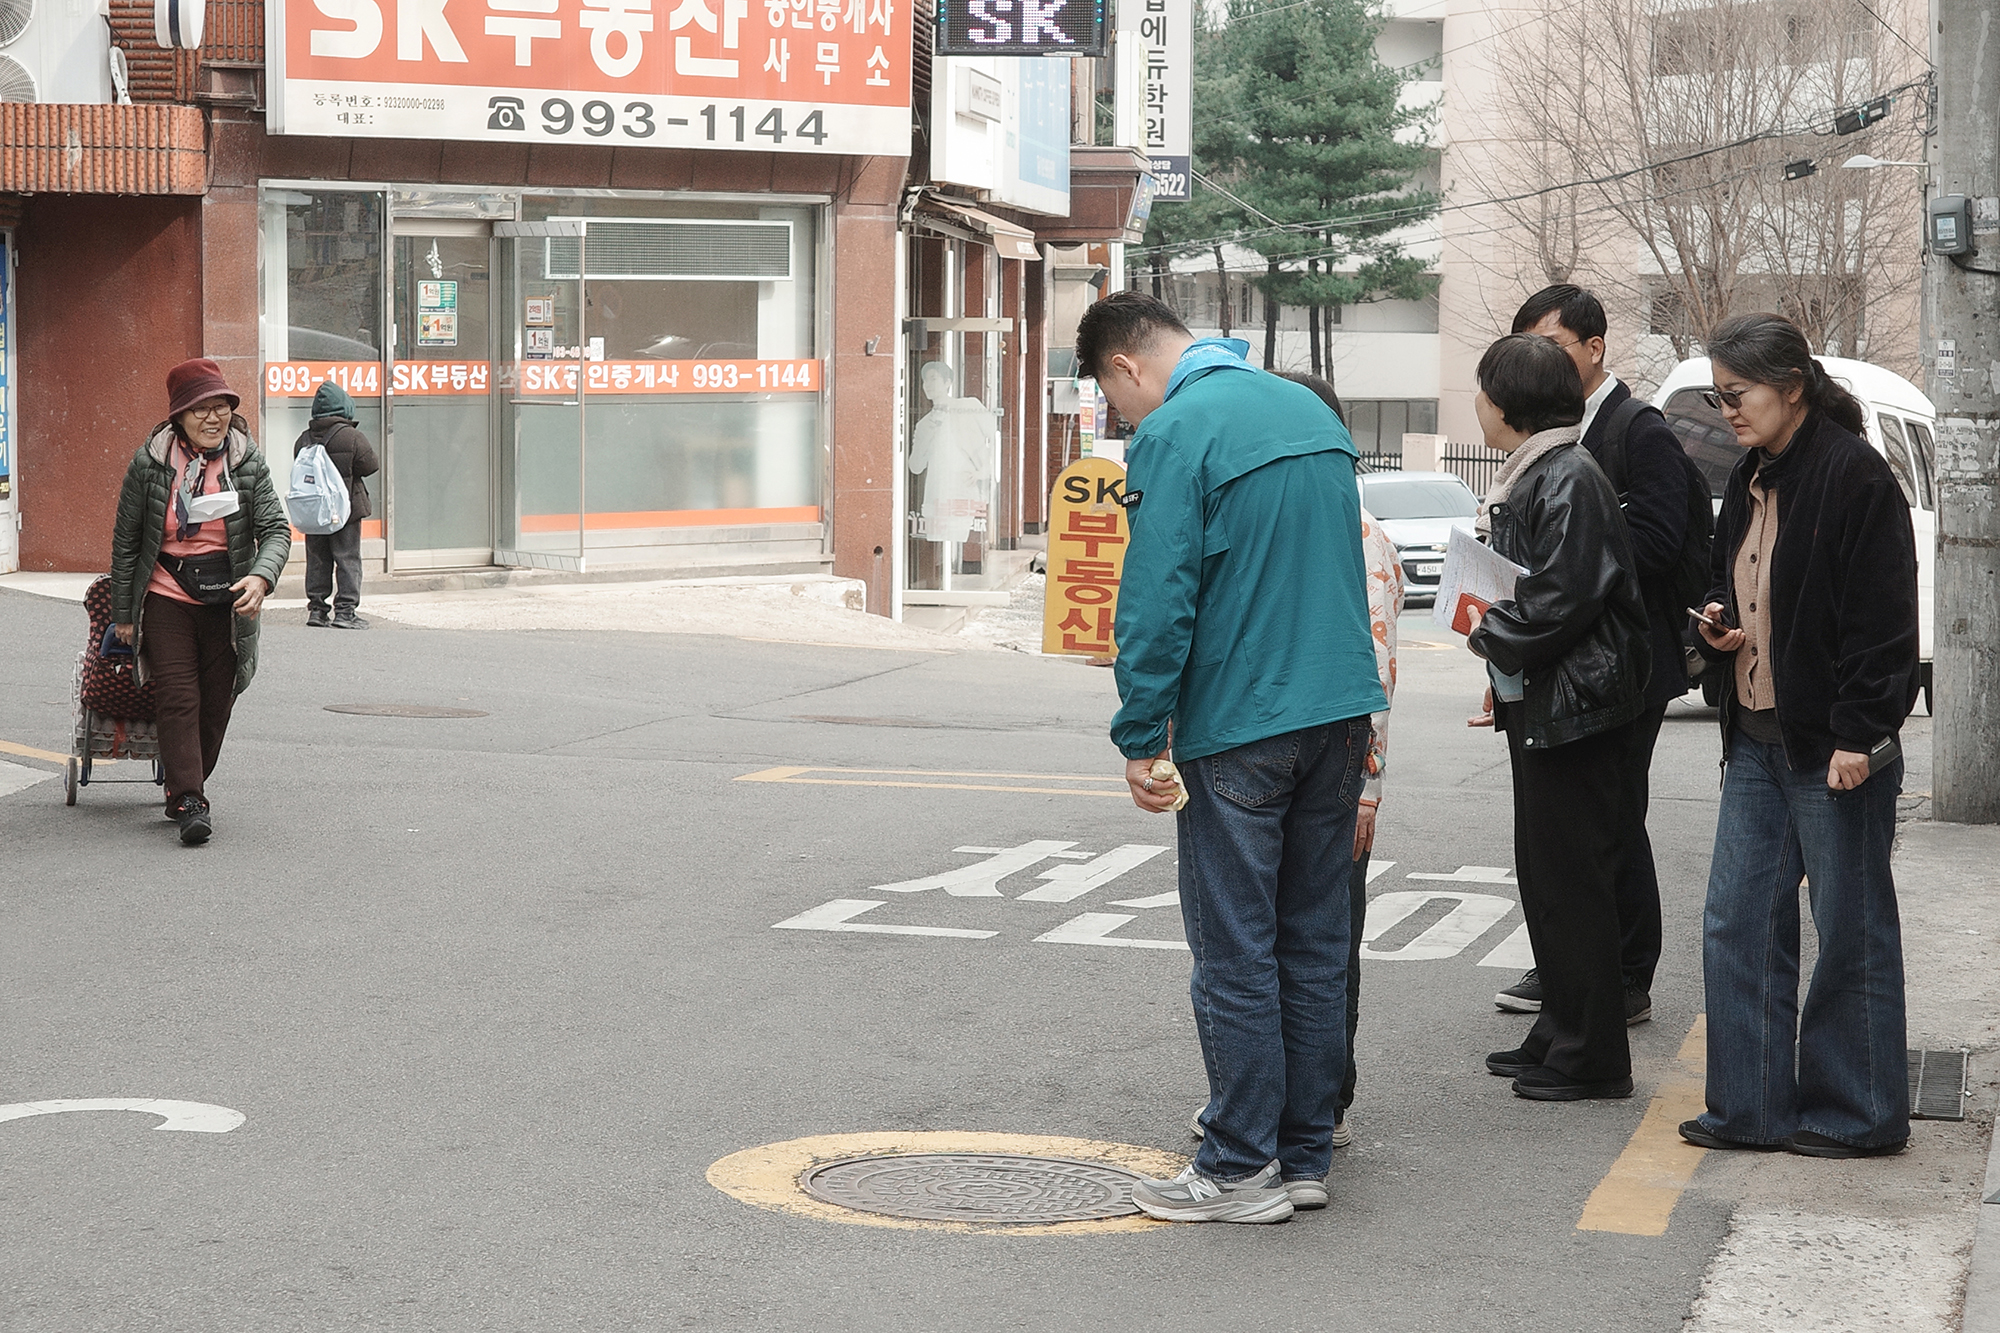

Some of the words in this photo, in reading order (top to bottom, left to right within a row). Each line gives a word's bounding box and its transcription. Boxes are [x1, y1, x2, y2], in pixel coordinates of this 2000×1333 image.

[968, 0, 1075, 44] SK
[541, 97, 828, 146] 993-1144
[1149, 160, 1171, 170] 상담
[267, 366, 378, 392] 993-1144
[692, 363, 810, 388] 993-1144
[1062, 476, 1125, 505] SK
[199, 581, 231, 591] Reebok
[1057, 511, 1125, 653] 부동산
